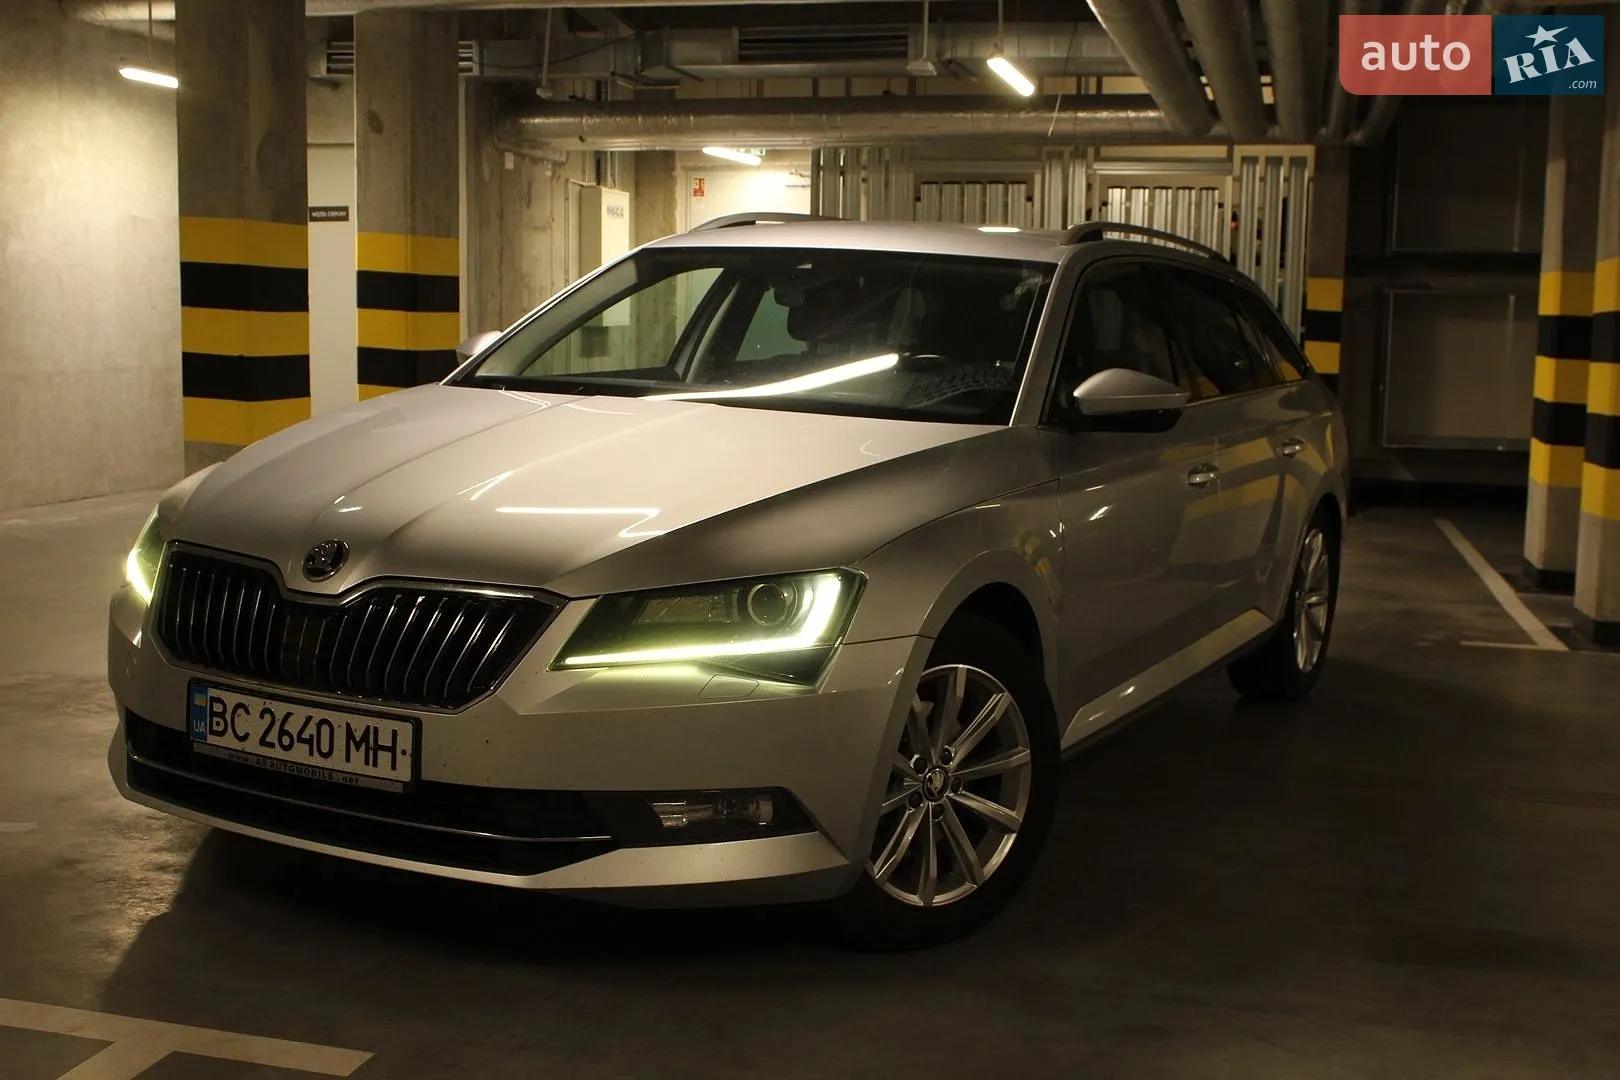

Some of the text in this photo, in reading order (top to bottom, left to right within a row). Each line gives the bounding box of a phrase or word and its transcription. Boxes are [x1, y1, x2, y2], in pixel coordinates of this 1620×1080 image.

[193, 719, 206, 733] UA
[208, 695, 398, 771] BC 2640 MH
